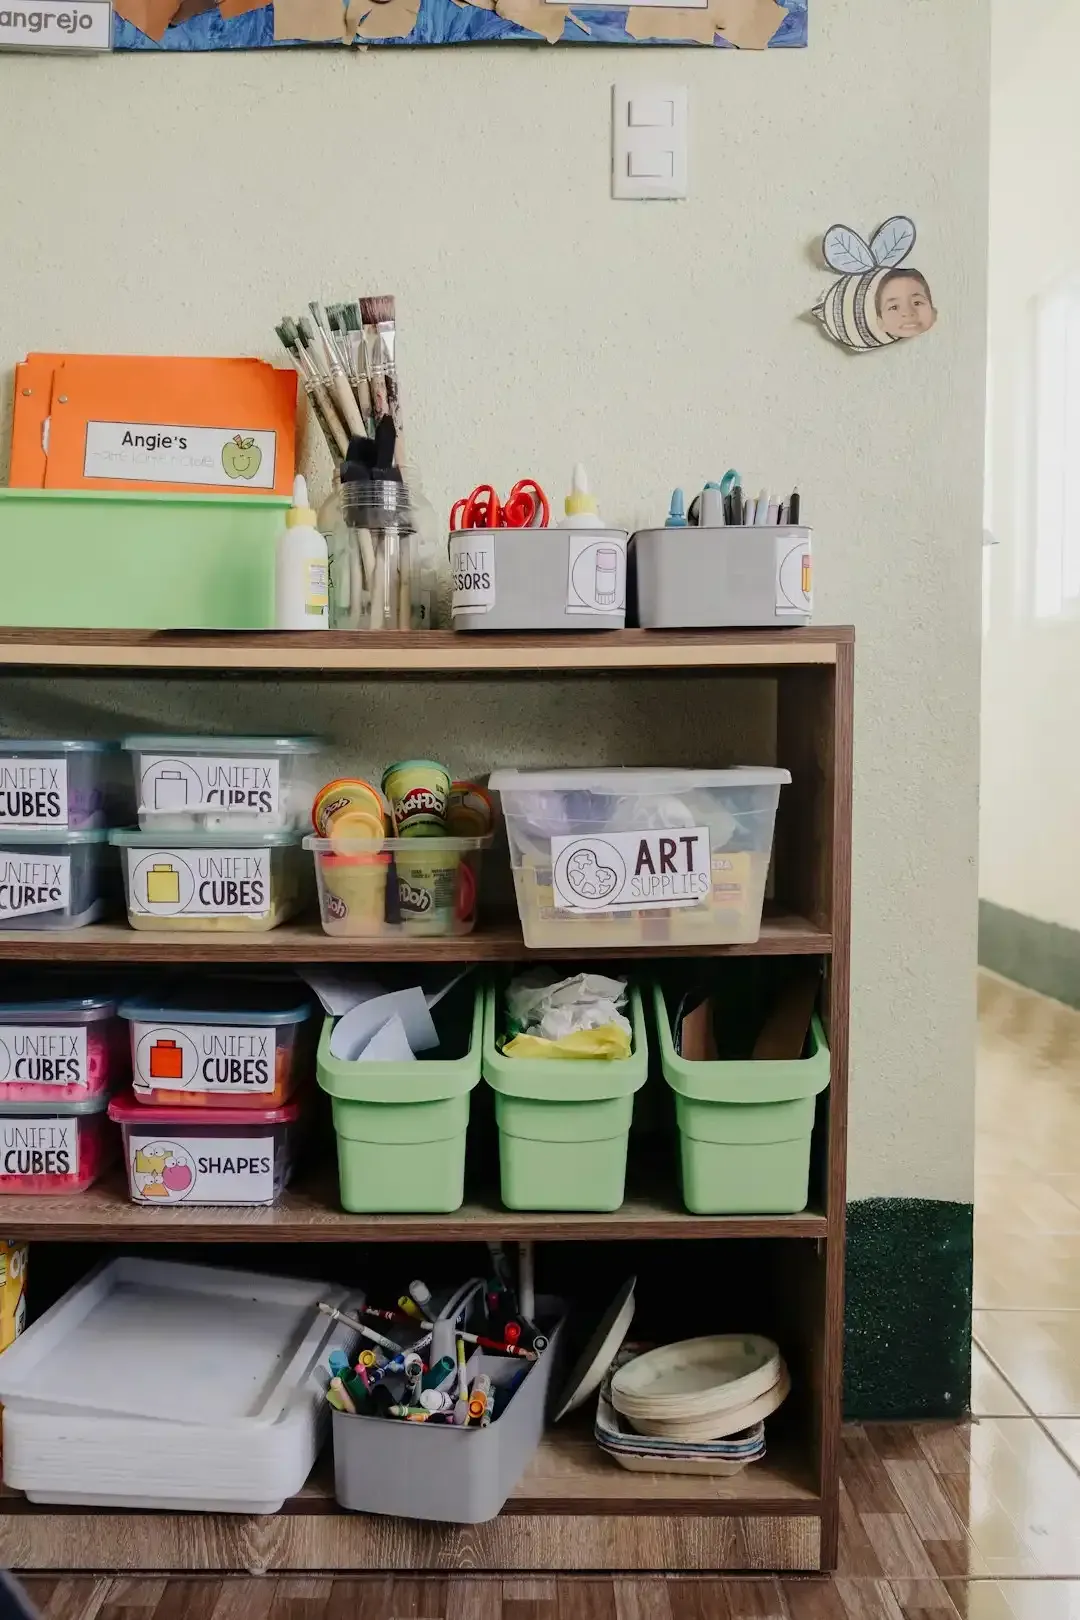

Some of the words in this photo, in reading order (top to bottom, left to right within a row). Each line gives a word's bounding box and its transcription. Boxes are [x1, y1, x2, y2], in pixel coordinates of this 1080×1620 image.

[0, 9, 93, 34] angrejo
[121, 431, 188, 451] Angie's
[207, 766, 272, 788] UNIFIX
[634, 835, 699, 876] ART
[198, 857, 263, 879] UNIFIX
[199, 880, 264, 906] CUBES
[631, 872, 709, 897] SUPPLIES
[14, 1035, 79, 1057] UNIFIX
[202, 1035, 267, 1057] UNIFIX
[15, 1058, 80, 1081] CUBES
[202, 1057, 268, 1084] CUBES
[4, 1127, 68, 1149] UNIFIX
[4, 1150, 70, 1174] CUBES
[198, 1157, 271, 1174] SHAPES
